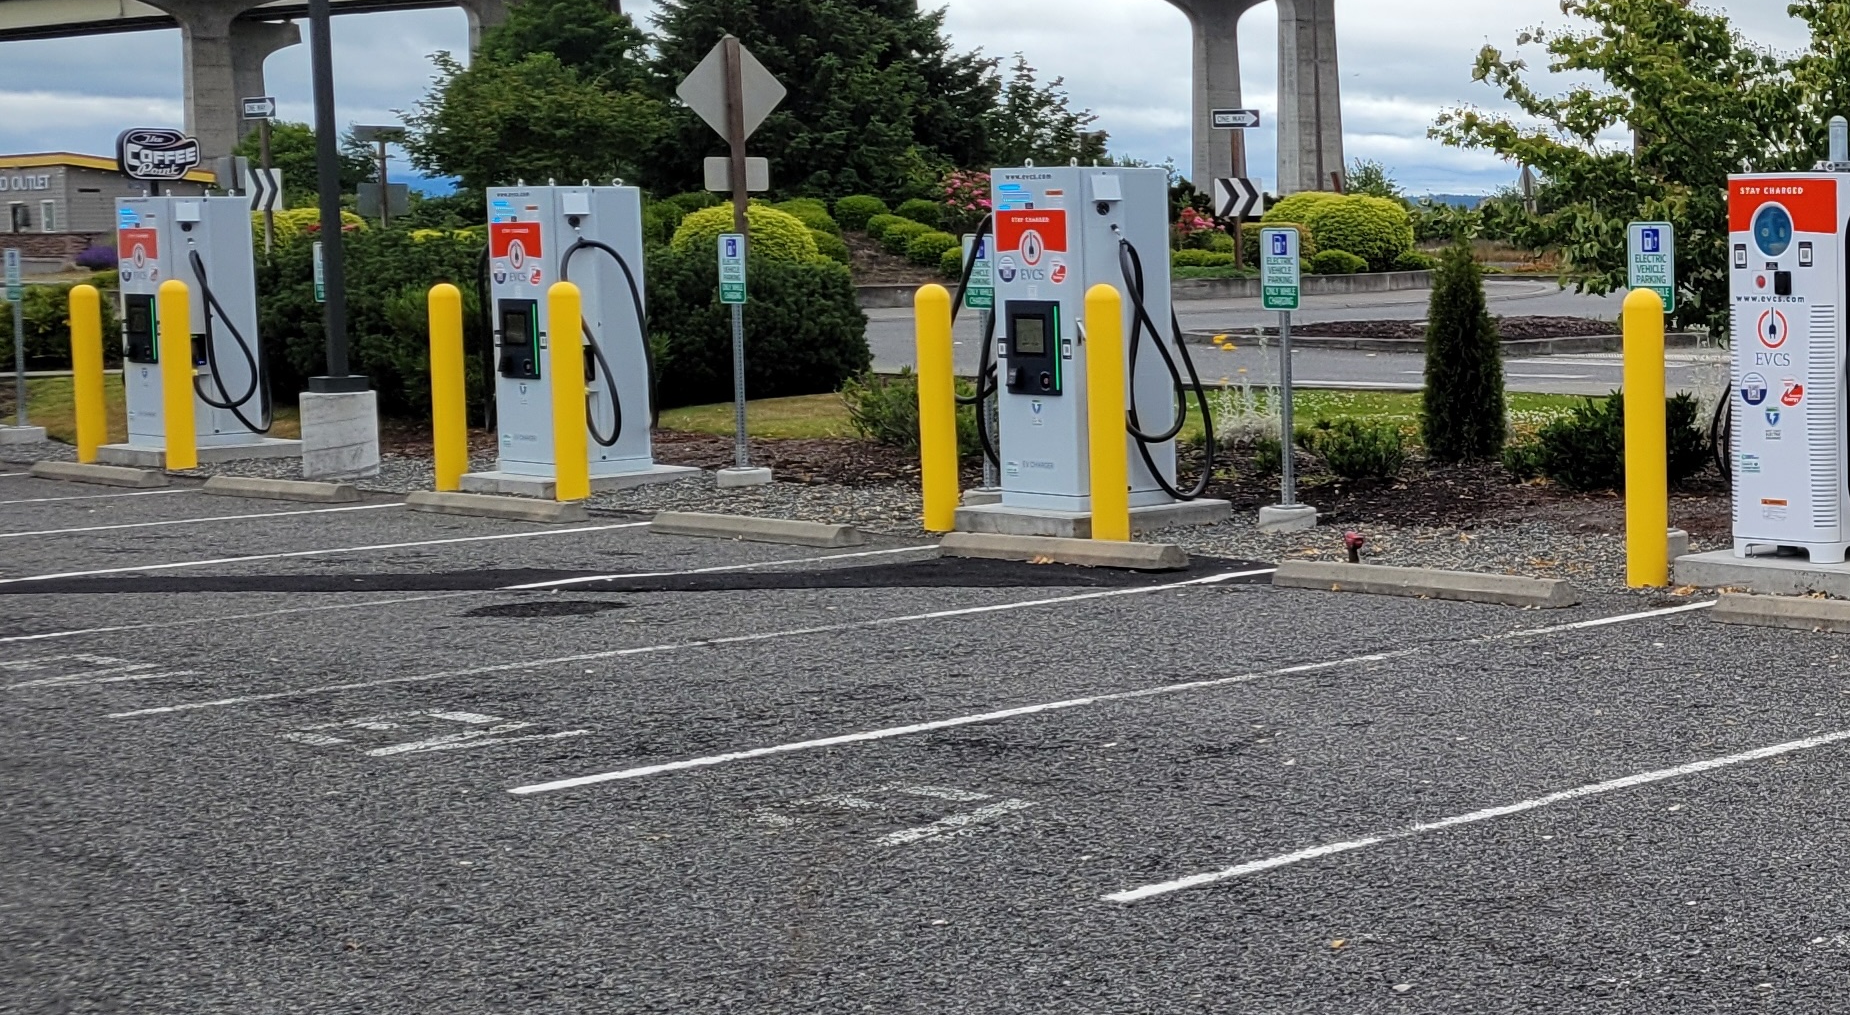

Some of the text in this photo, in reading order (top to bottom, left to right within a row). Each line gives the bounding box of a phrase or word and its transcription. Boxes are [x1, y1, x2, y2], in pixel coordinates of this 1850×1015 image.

[125, 143, 197, 166] COFFEE
[135, 163, 181, 176] Point
[11, 174, 51, 191] OUTLET
[1739, 186, 1804, 195] STAY CHARGED
[1634, 254, 1667, 264] ELECTRIC
[1020, 268, 1044, 281] EVCS
[1636, 264, 1665, 274] VEHICLE
[1636, 275, 1667, 284] PARKING
[1735, 295, 1805, 303] www.evcs.com
[1755, 351, 1791, 367] EVCS
